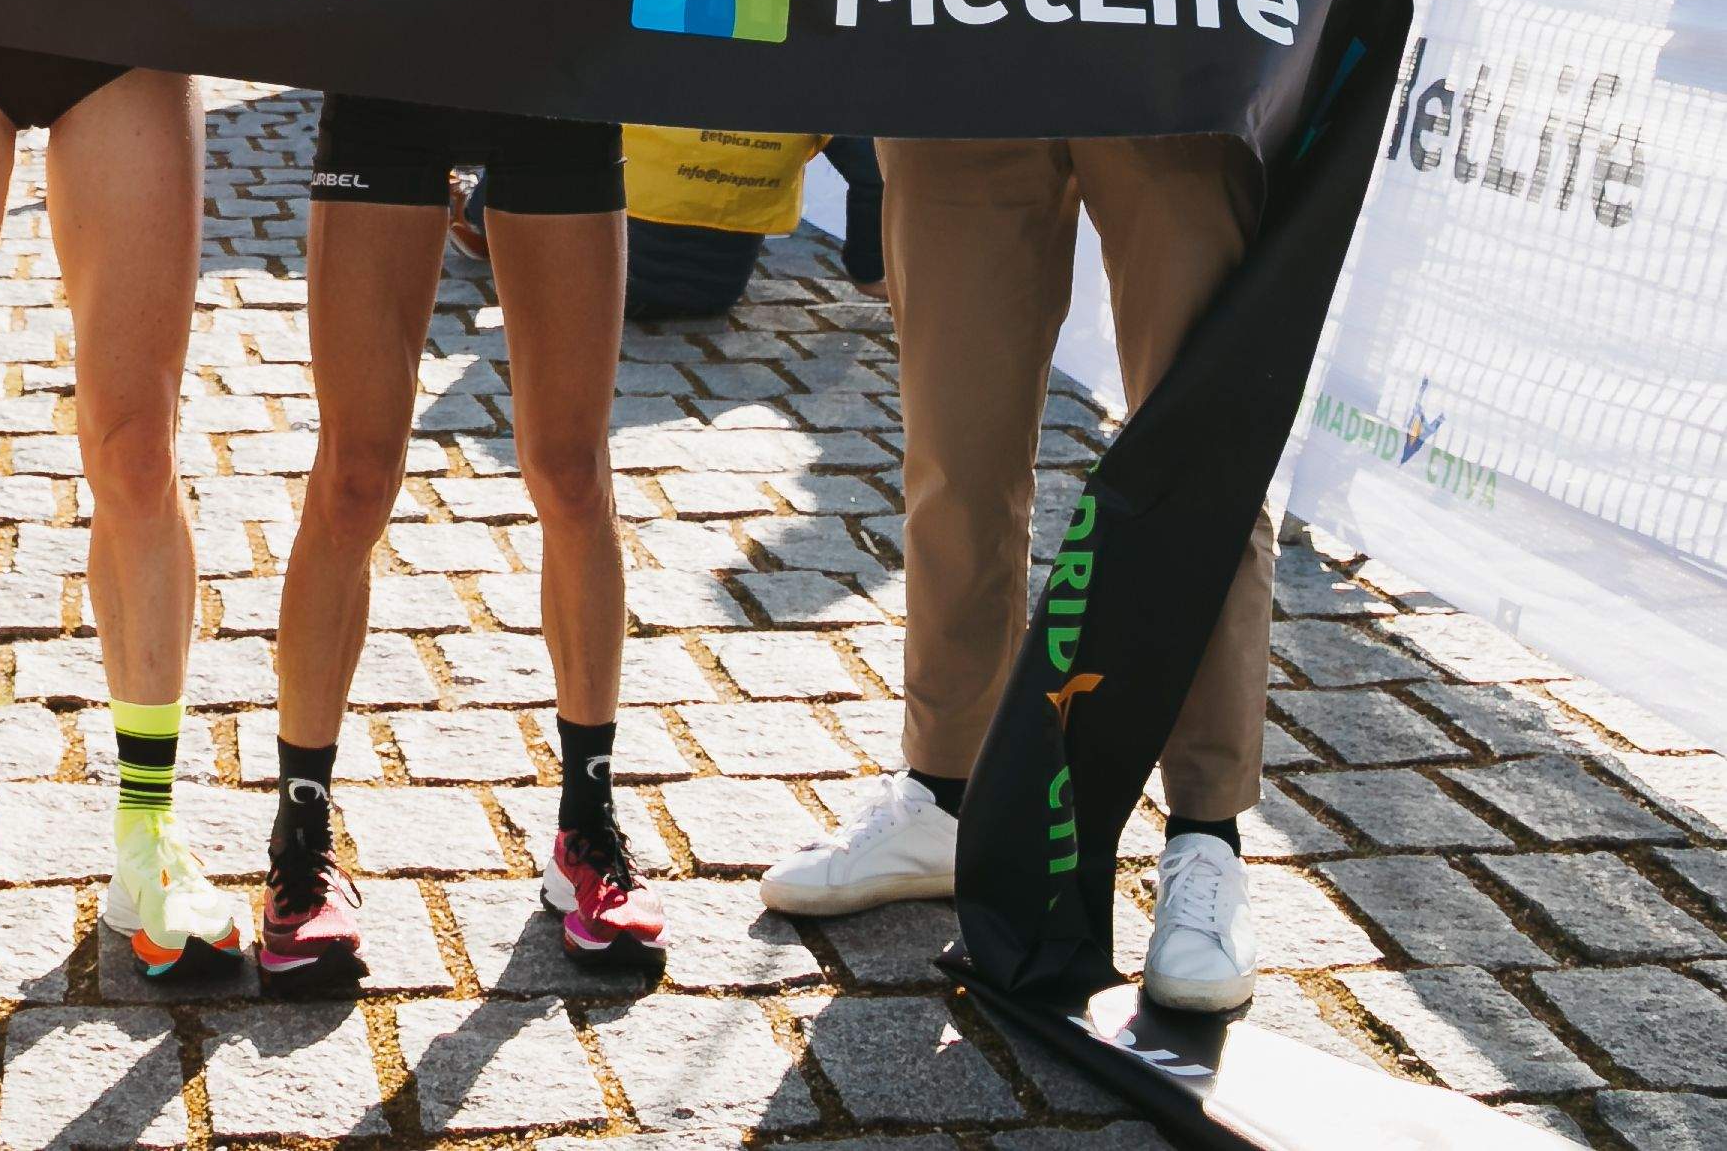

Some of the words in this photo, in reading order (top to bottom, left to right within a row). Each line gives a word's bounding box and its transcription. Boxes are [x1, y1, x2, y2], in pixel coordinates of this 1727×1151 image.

[311, 172, 370, 188] URBEL
[1311, 392, 1399, 461] MADRID
[1048, 495, 1096, 673] DRID
